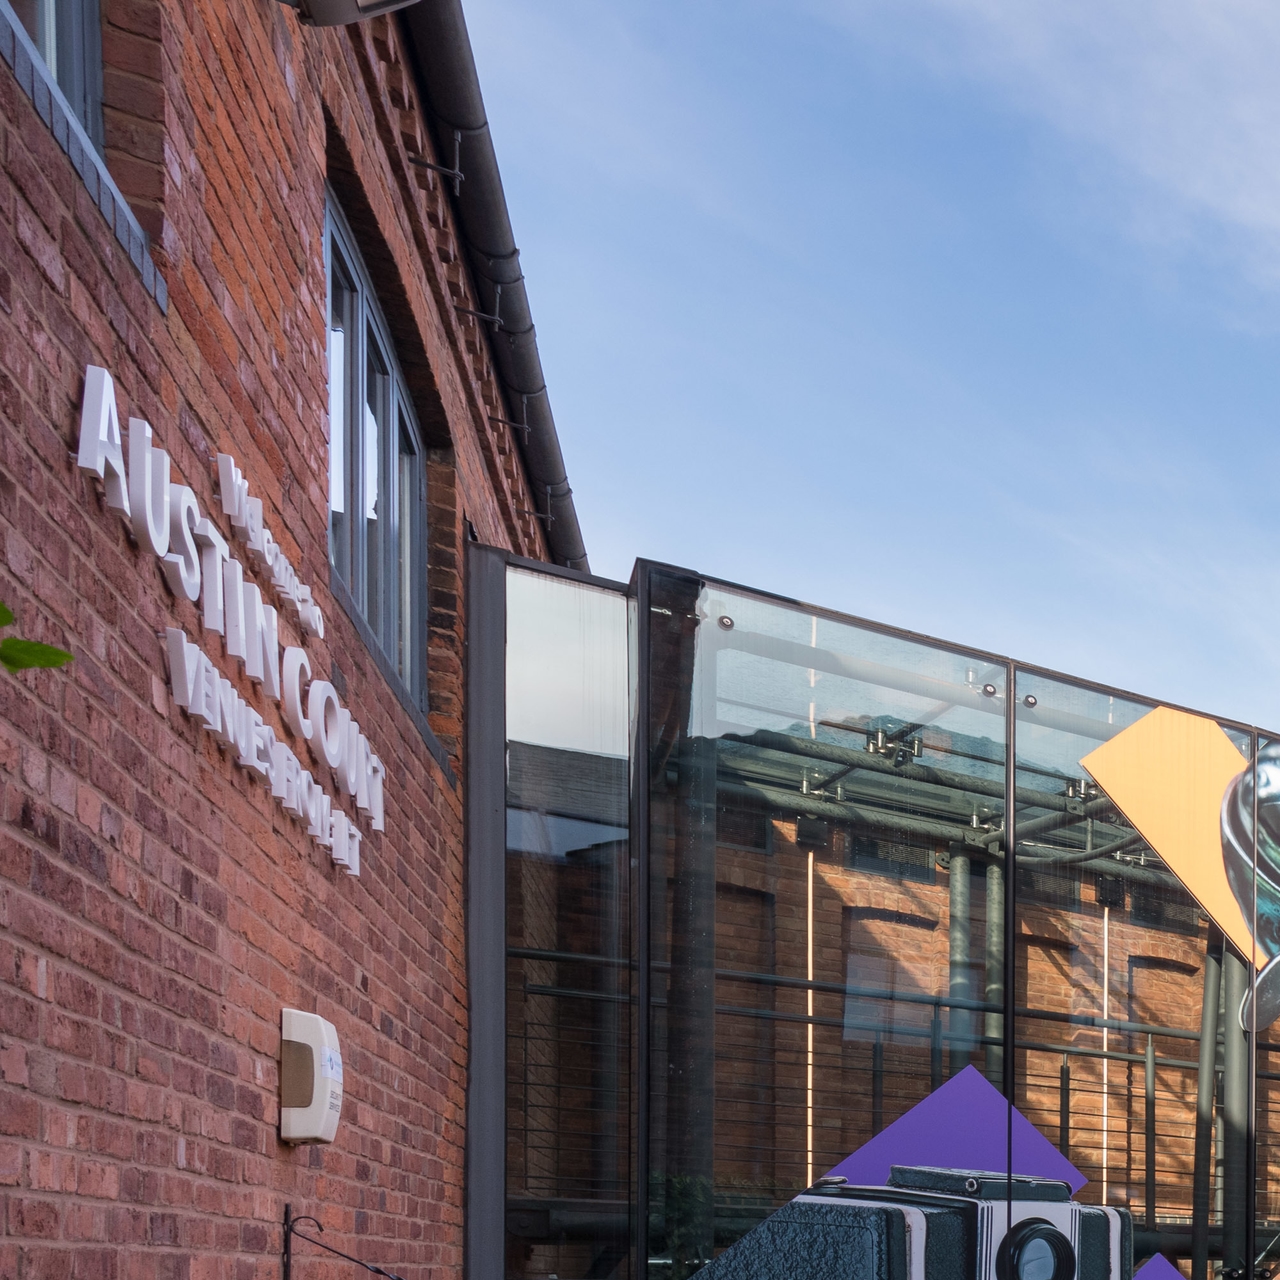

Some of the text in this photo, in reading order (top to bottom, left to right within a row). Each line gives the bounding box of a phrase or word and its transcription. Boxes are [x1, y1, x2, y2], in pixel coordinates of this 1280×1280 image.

[77, 364, 386, 832] AUSTIN COURT
[217, 453, 324, 639] Welcome to
[166, 627, 278, 786] VENUES
